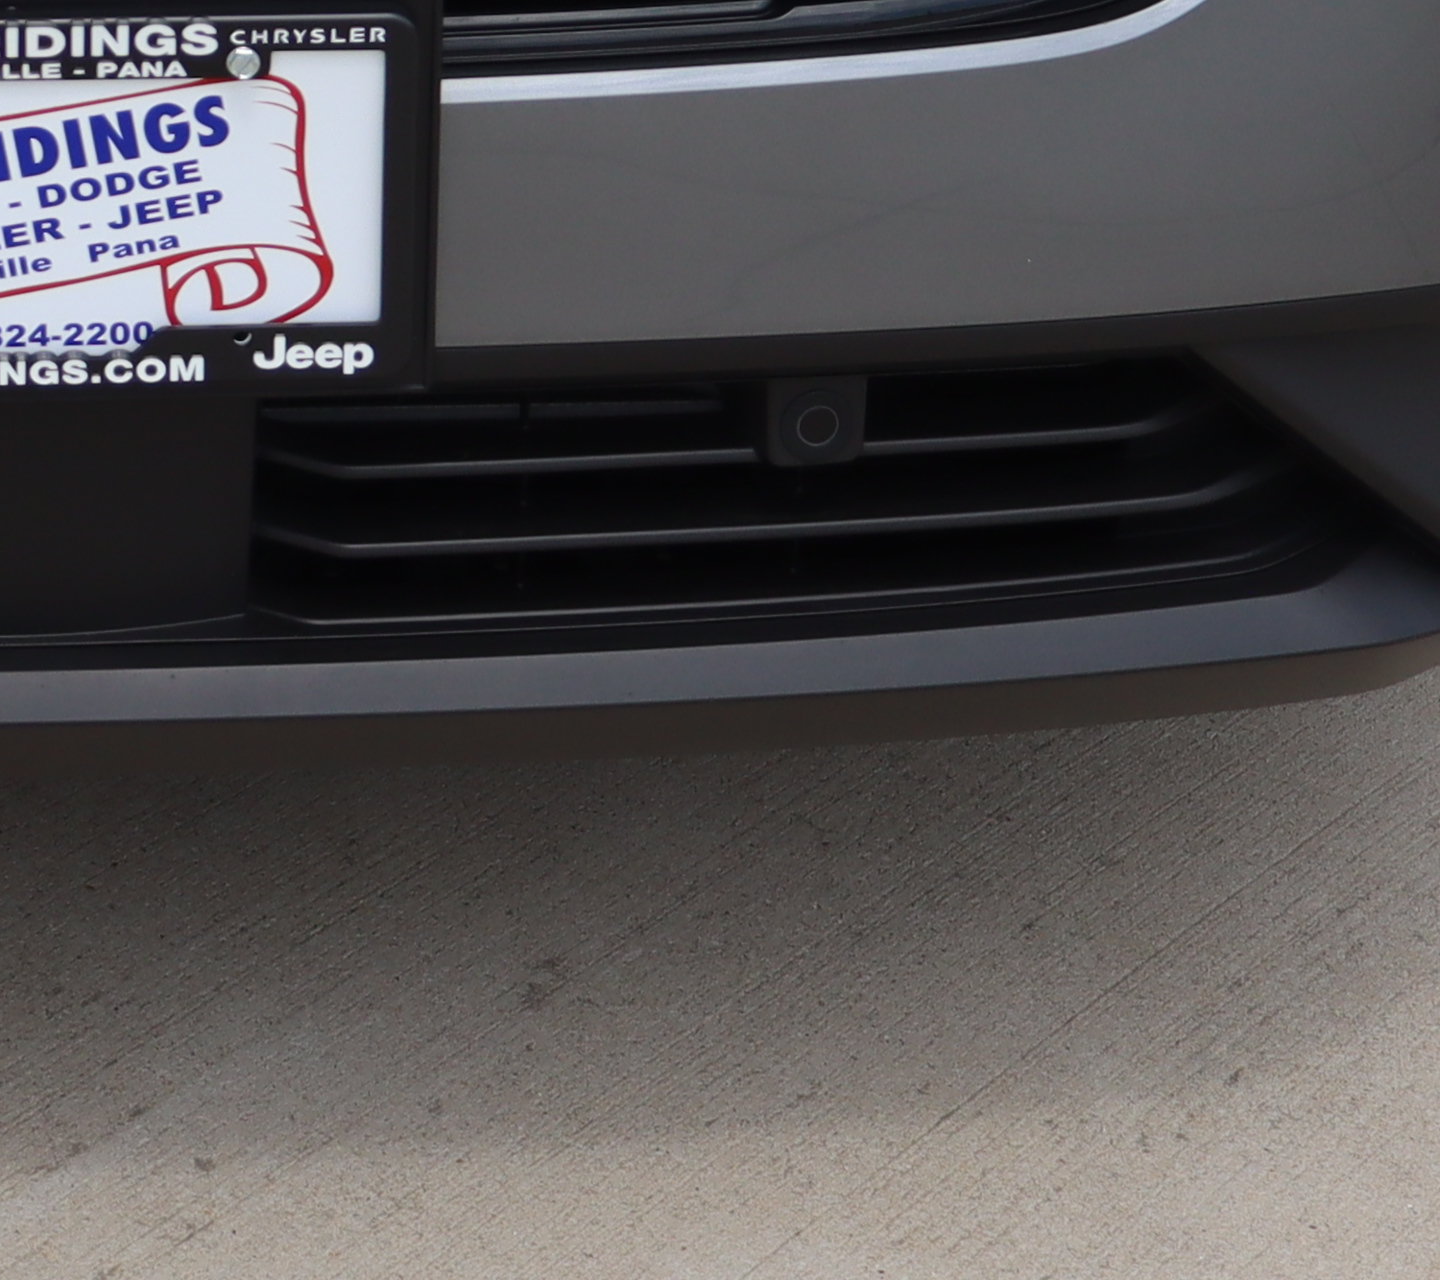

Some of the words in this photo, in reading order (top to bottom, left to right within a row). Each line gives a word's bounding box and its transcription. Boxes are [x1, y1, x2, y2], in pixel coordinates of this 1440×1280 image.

[229, 26, 387, 45] CHRYSLER
[96, 60, 188, 79] PANA
[36, 159, 202, 209] DODGE
[107, 189, 224, 230] JEEP
[87, 234, 181, 263] Pana
[252, 333, 376, 375] Jeep
